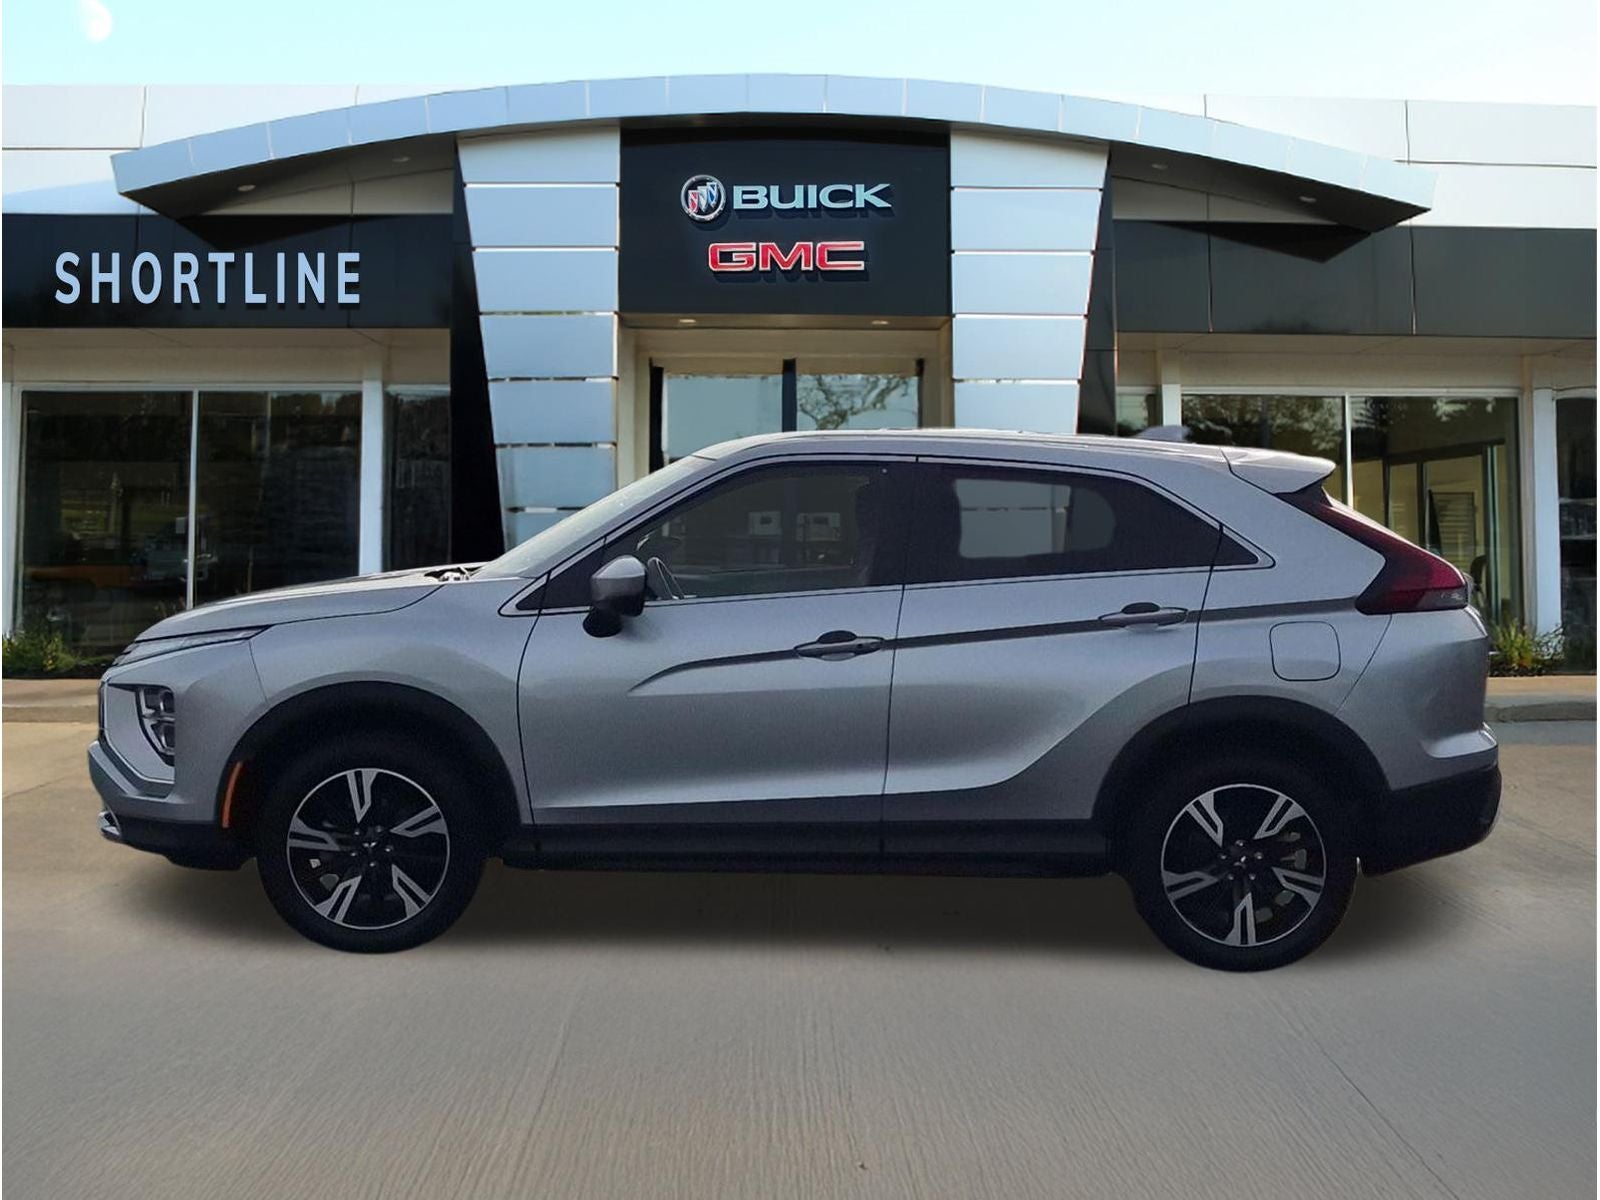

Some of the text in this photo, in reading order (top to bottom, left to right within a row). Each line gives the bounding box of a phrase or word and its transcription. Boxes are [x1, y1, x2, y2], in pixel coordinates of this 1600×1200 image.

[733, 183, 893, 210] BUICK
[708, 241, 865, 272] GMC
[54, 251, 361, 305] SHORTLINE
